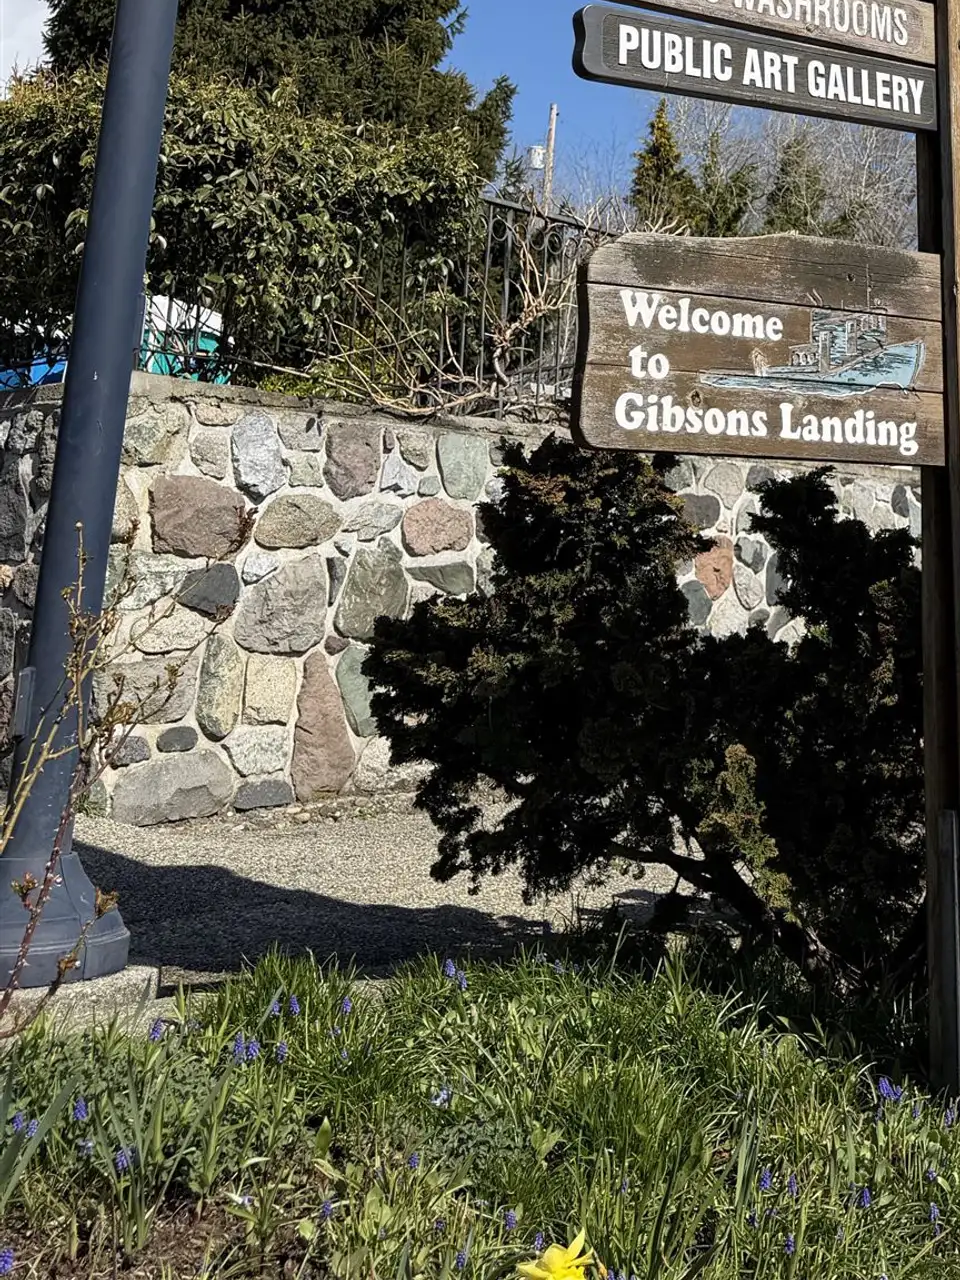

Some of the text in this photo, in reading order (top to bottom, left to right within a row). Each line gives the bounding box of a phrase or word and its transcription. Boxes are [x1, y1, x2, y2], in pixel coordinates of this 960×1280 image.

[618, 23, 925, 116] PUBLIC ART GALLERY
[619, 289, 784, 342] Welcome
[628, 344, 670, 381] to
[614, 392, 919, 457] Gibsons Landing
